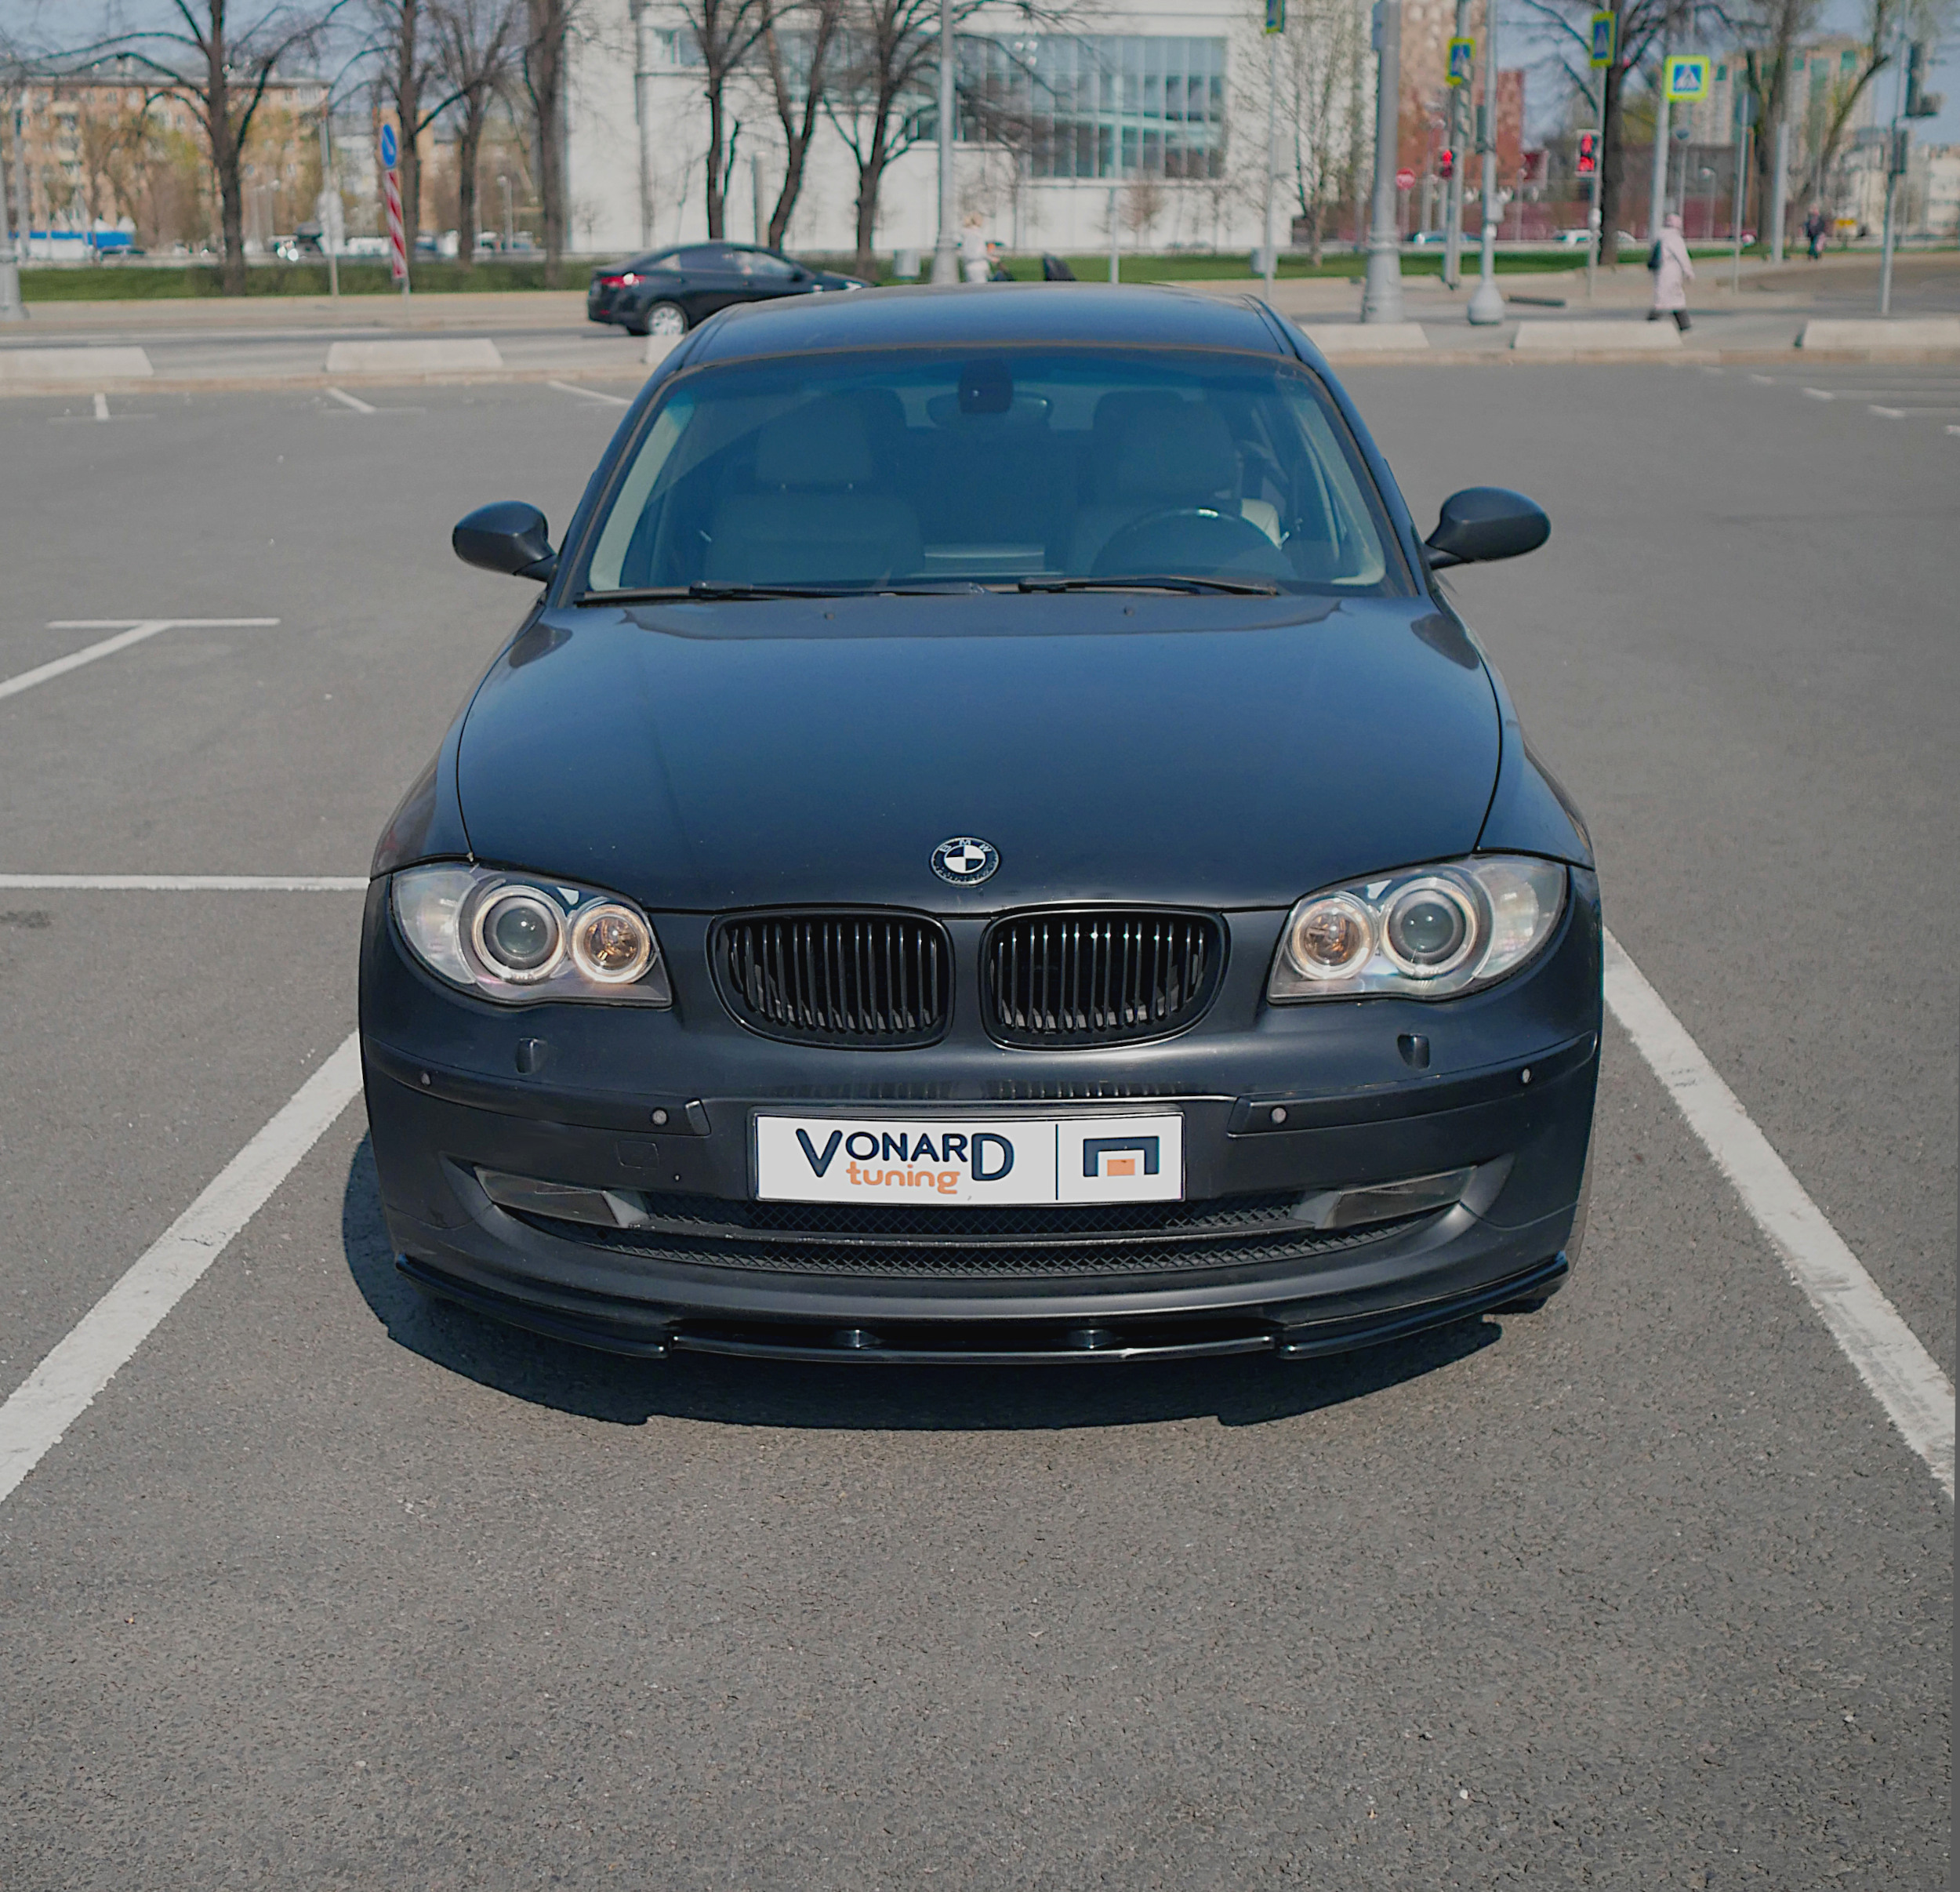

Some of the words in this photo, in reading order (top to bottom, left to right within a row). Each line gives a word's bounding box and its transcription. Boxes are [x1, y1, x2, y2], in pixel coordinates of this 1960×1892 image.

[938, 840, 993, 852] BMW
[796, 1128, 1014, 1182] VONARD
[846, 1161, 961, 1194] tuning
